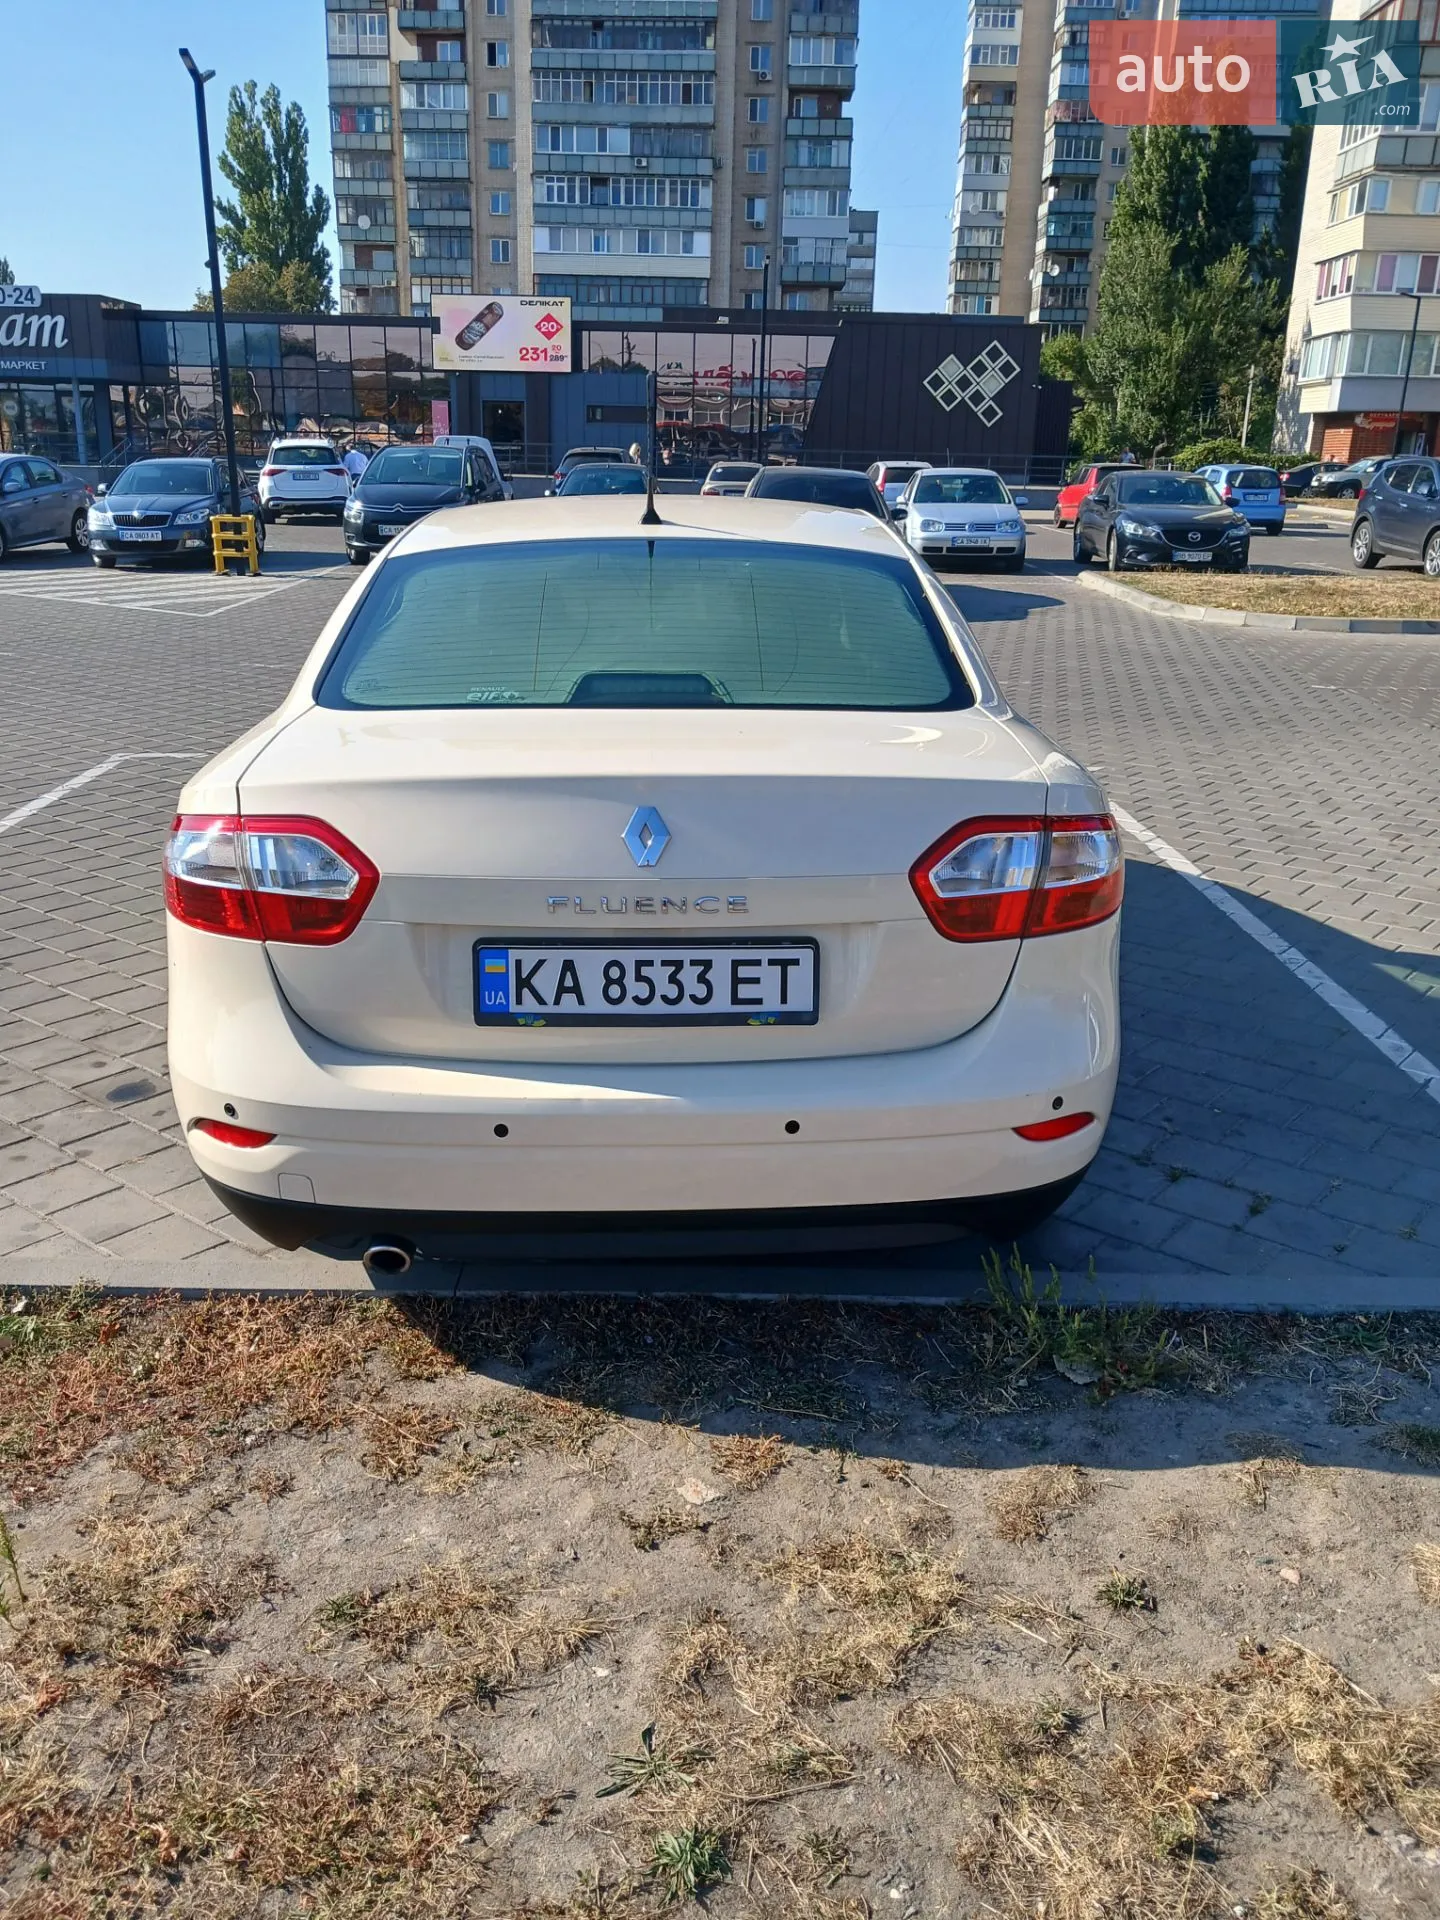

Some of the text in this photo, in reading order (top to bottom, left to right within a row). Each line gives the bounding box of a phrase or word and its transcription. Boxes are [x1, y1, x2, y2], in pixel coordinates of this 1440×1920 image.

[519, 347, 548, 361] 231
[0, 361, 47, 370] МАРКЕТ
[546, 896, 749, 914] FLUENCE
[515, 958, 800, 1006] KA 8533 ET
[485, 991, 506, 1005] UA
